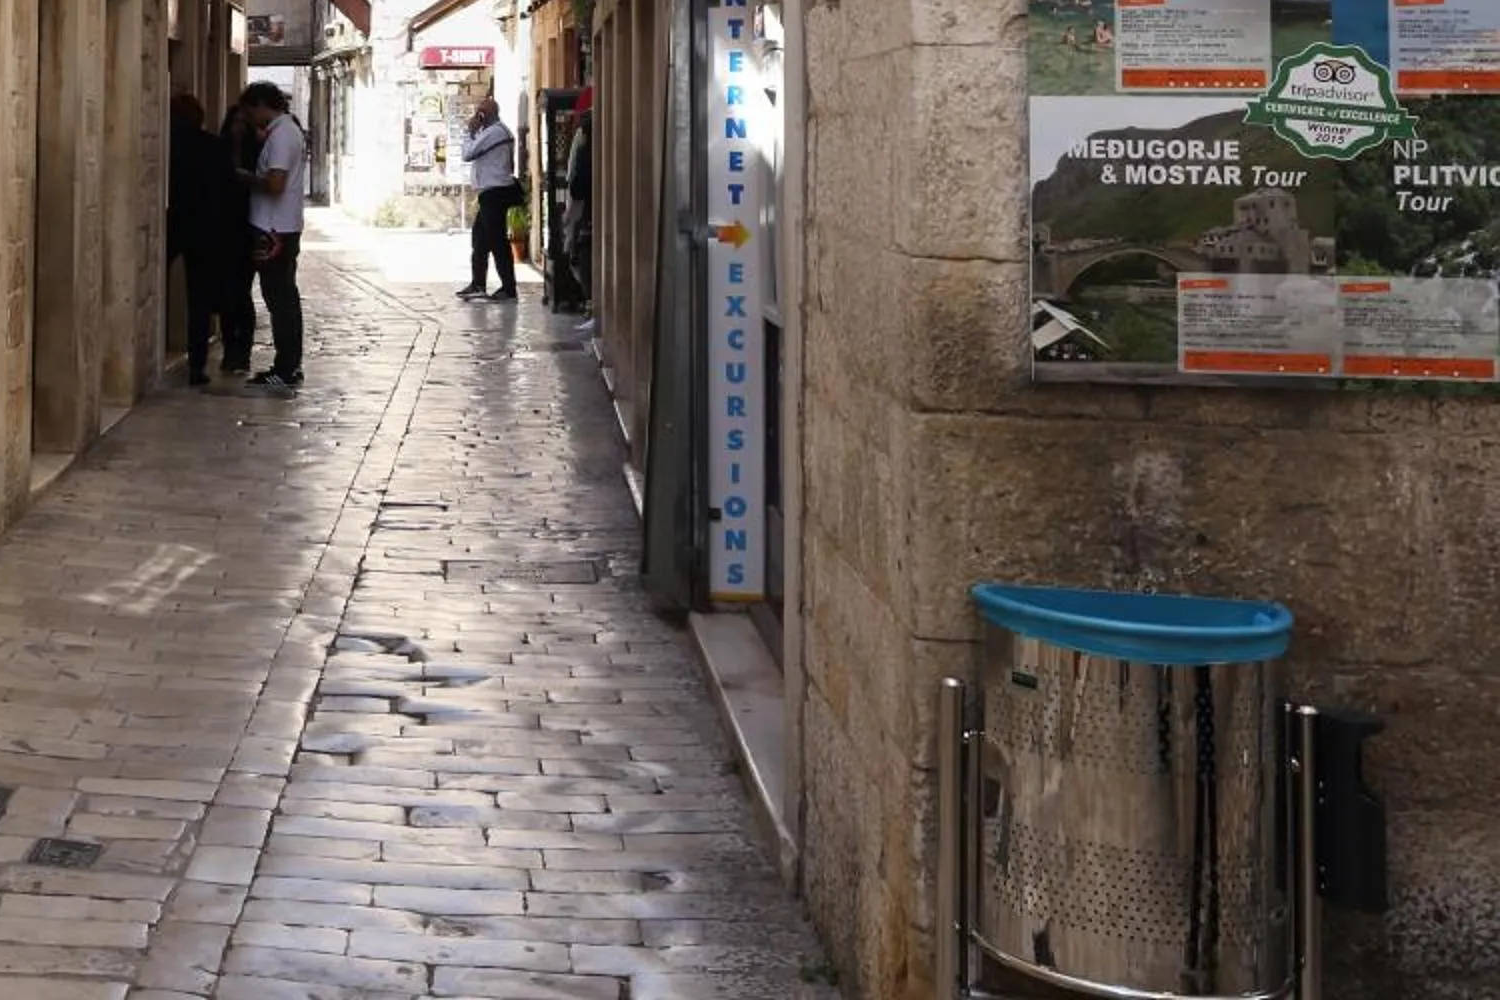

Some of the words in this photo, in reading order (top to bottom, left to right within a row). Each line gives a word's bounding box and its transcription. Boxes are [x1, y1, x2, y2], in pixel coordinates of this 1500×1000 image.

[1290, 83, 1373, 102] tripadvisor
[1307, 121, 1356, 135] Winner
[1315, 131, 1346, 145] 2015
[1067, 139, 1240, 162] MEĐUGORJE
[1392, 139, 1429, 159] NP
[1100, 165, 1118, 185] &
[1124, 164, 1242, 186] MOSTAR
[1251, 166, 1307, 187] Tour
[1396, 190, 1453, 213] Tour
[724, 262, 749, 586] EXCURSIONS
